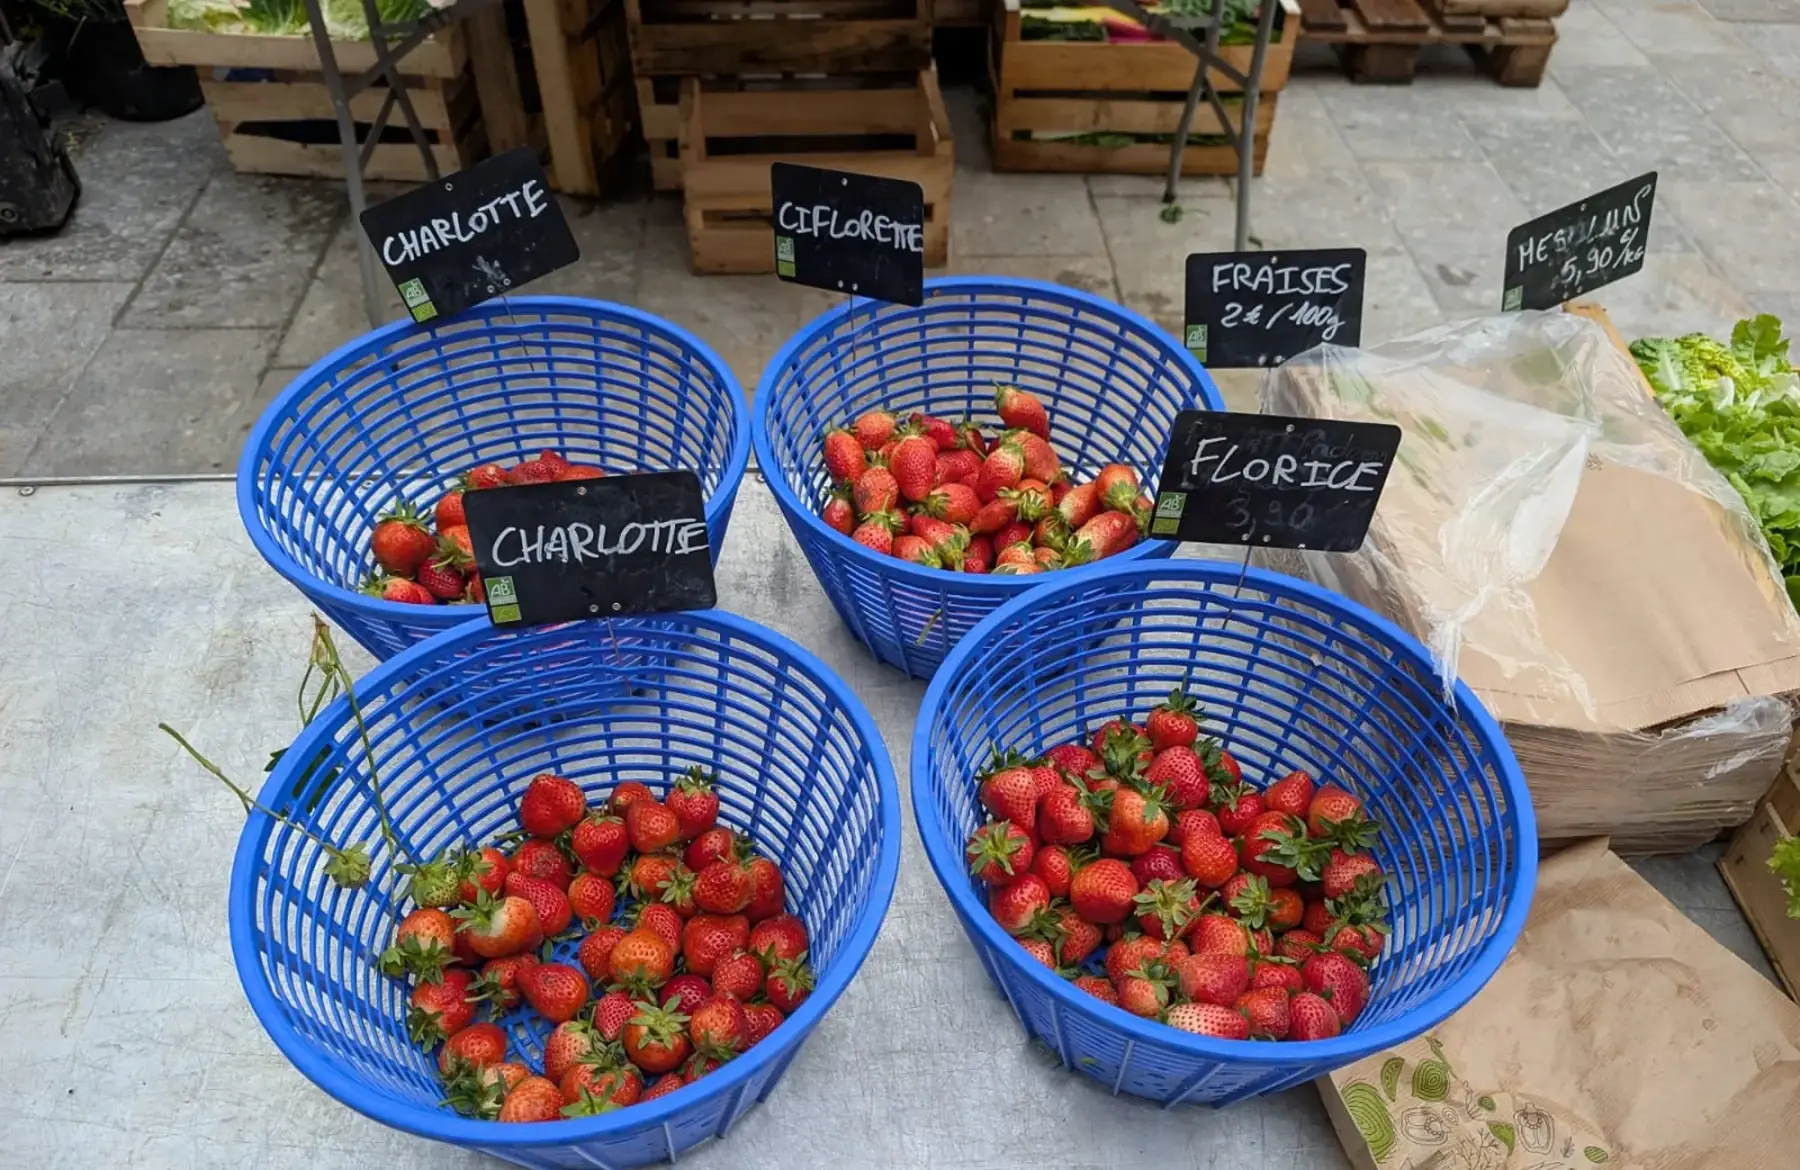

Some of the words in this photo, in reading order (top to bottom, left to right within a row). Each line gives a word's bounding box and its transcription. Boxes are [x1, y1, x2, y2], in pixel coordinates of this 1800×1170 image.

[383, 179, 548, 266] CHARLOTTE
[779, 201, 924, 253] CIFLORETTE
[1518, 183, 1652, 272] MESLUN
[1212, 263, 1352, 294] FRAISES
[1190, 436, 1384, 491] FLORICE
[491, 518, 710, 568] CHARLOTTE
